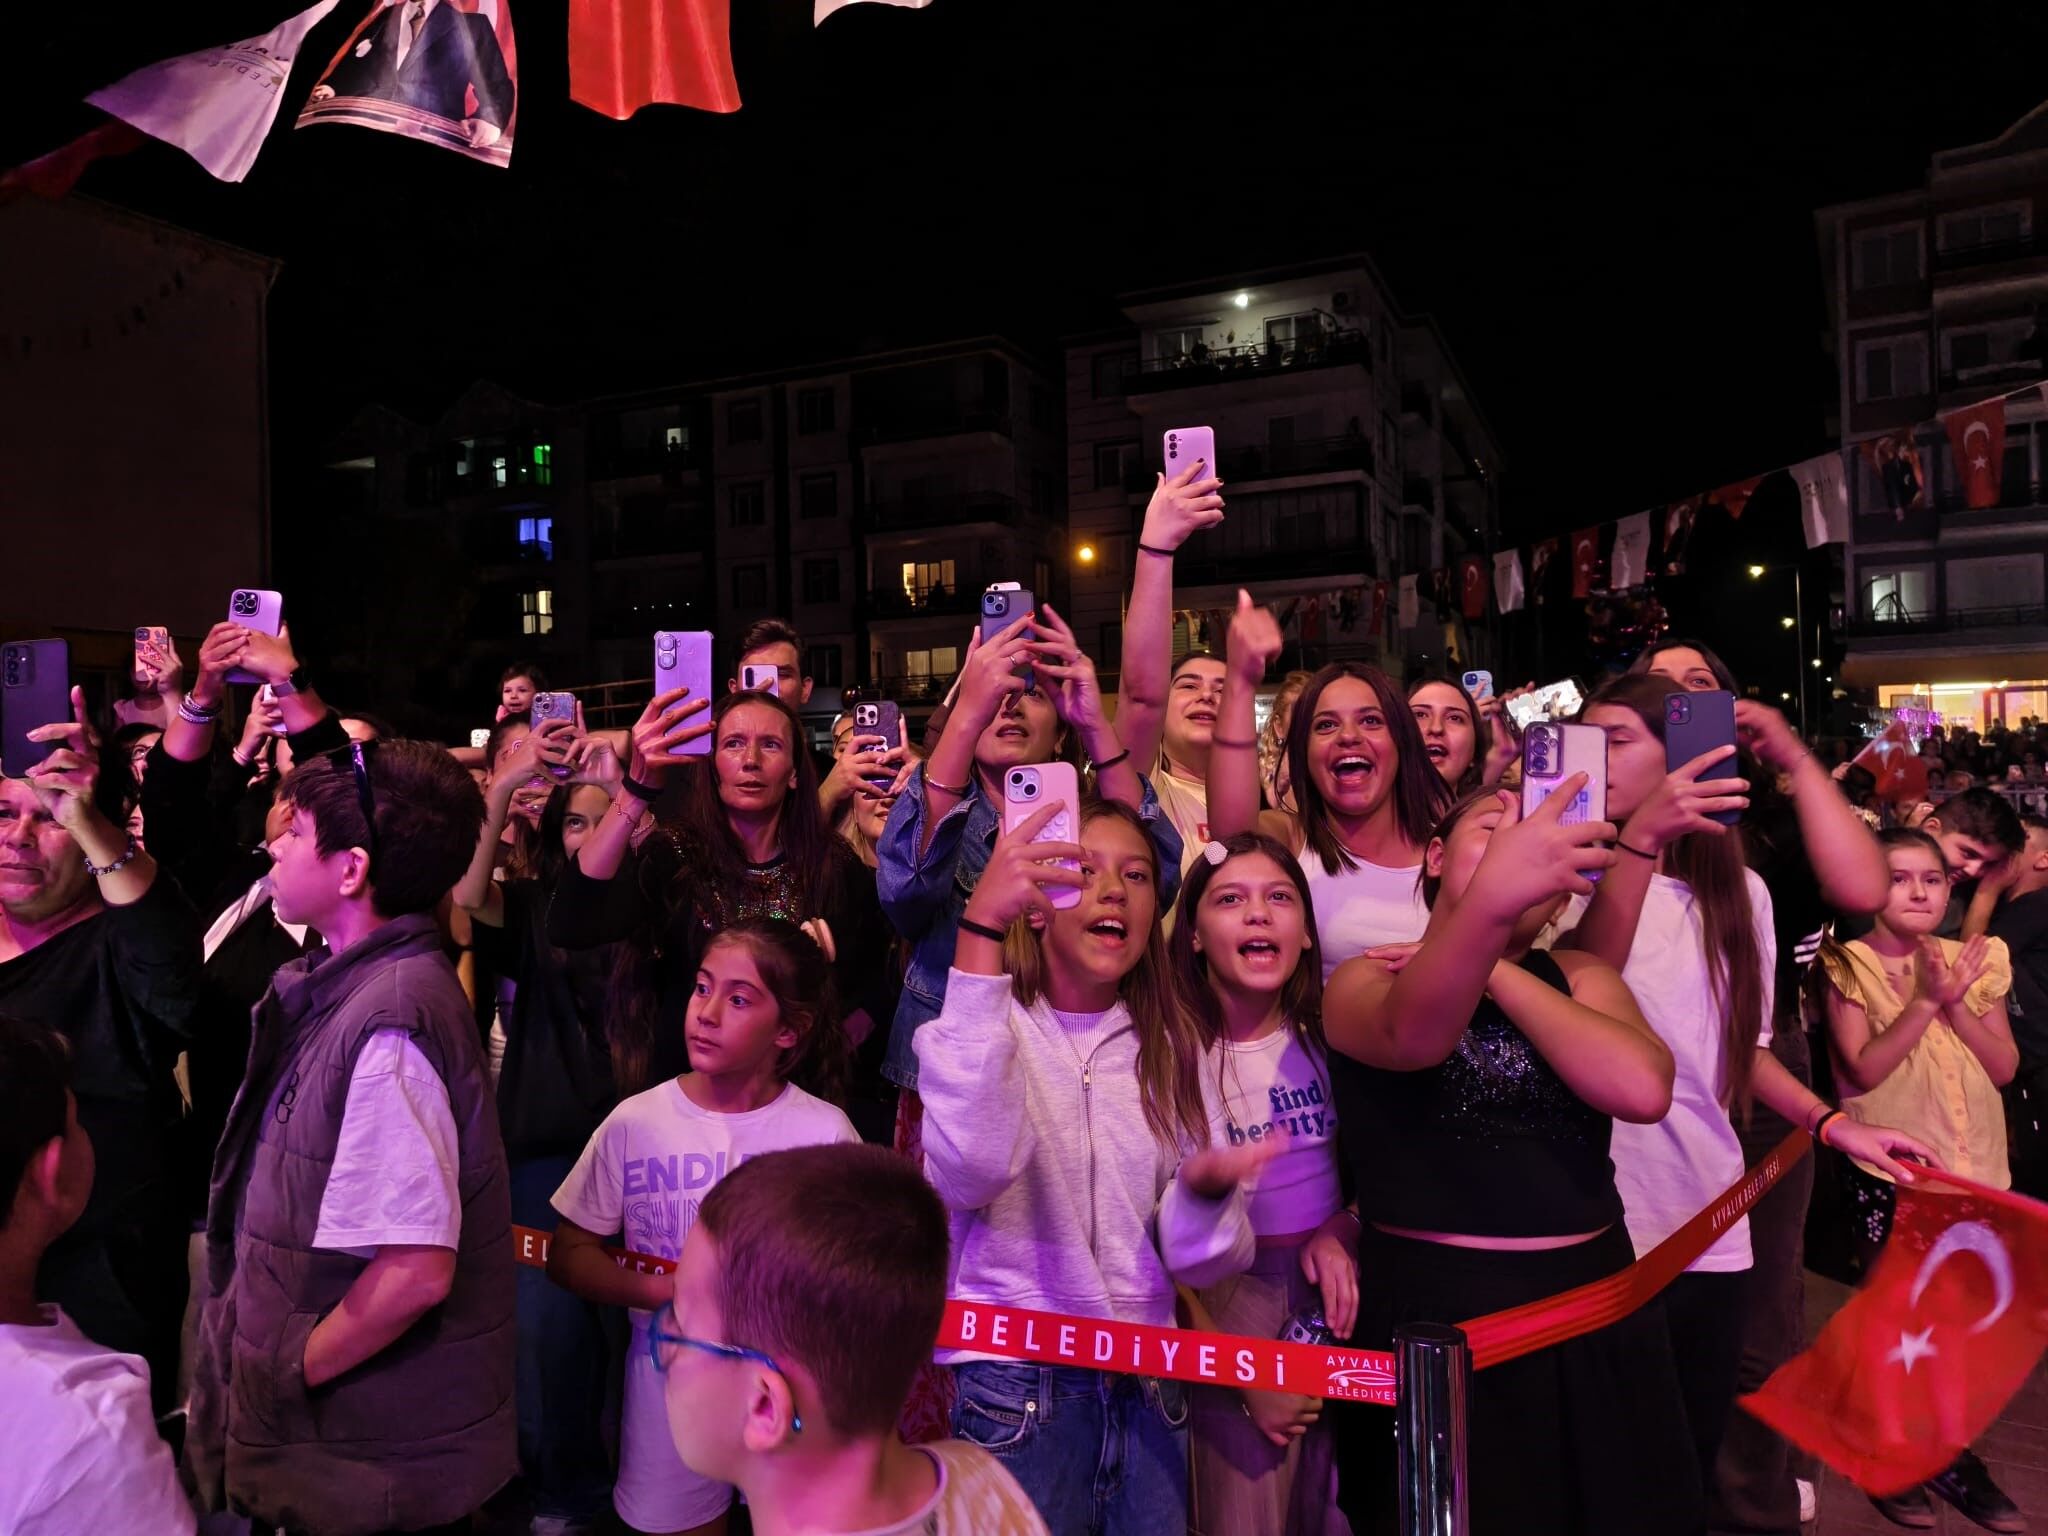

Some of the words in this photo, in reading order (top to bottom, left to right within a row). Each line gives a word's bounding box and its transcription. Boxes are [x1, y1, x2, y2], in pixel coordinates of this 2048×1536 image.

[1268, 1080, 1323, 1113] find
[1712, 1192, 1743, 1231] AYVALIK
[1327, 1355, 1396, 1371] AYVALI
